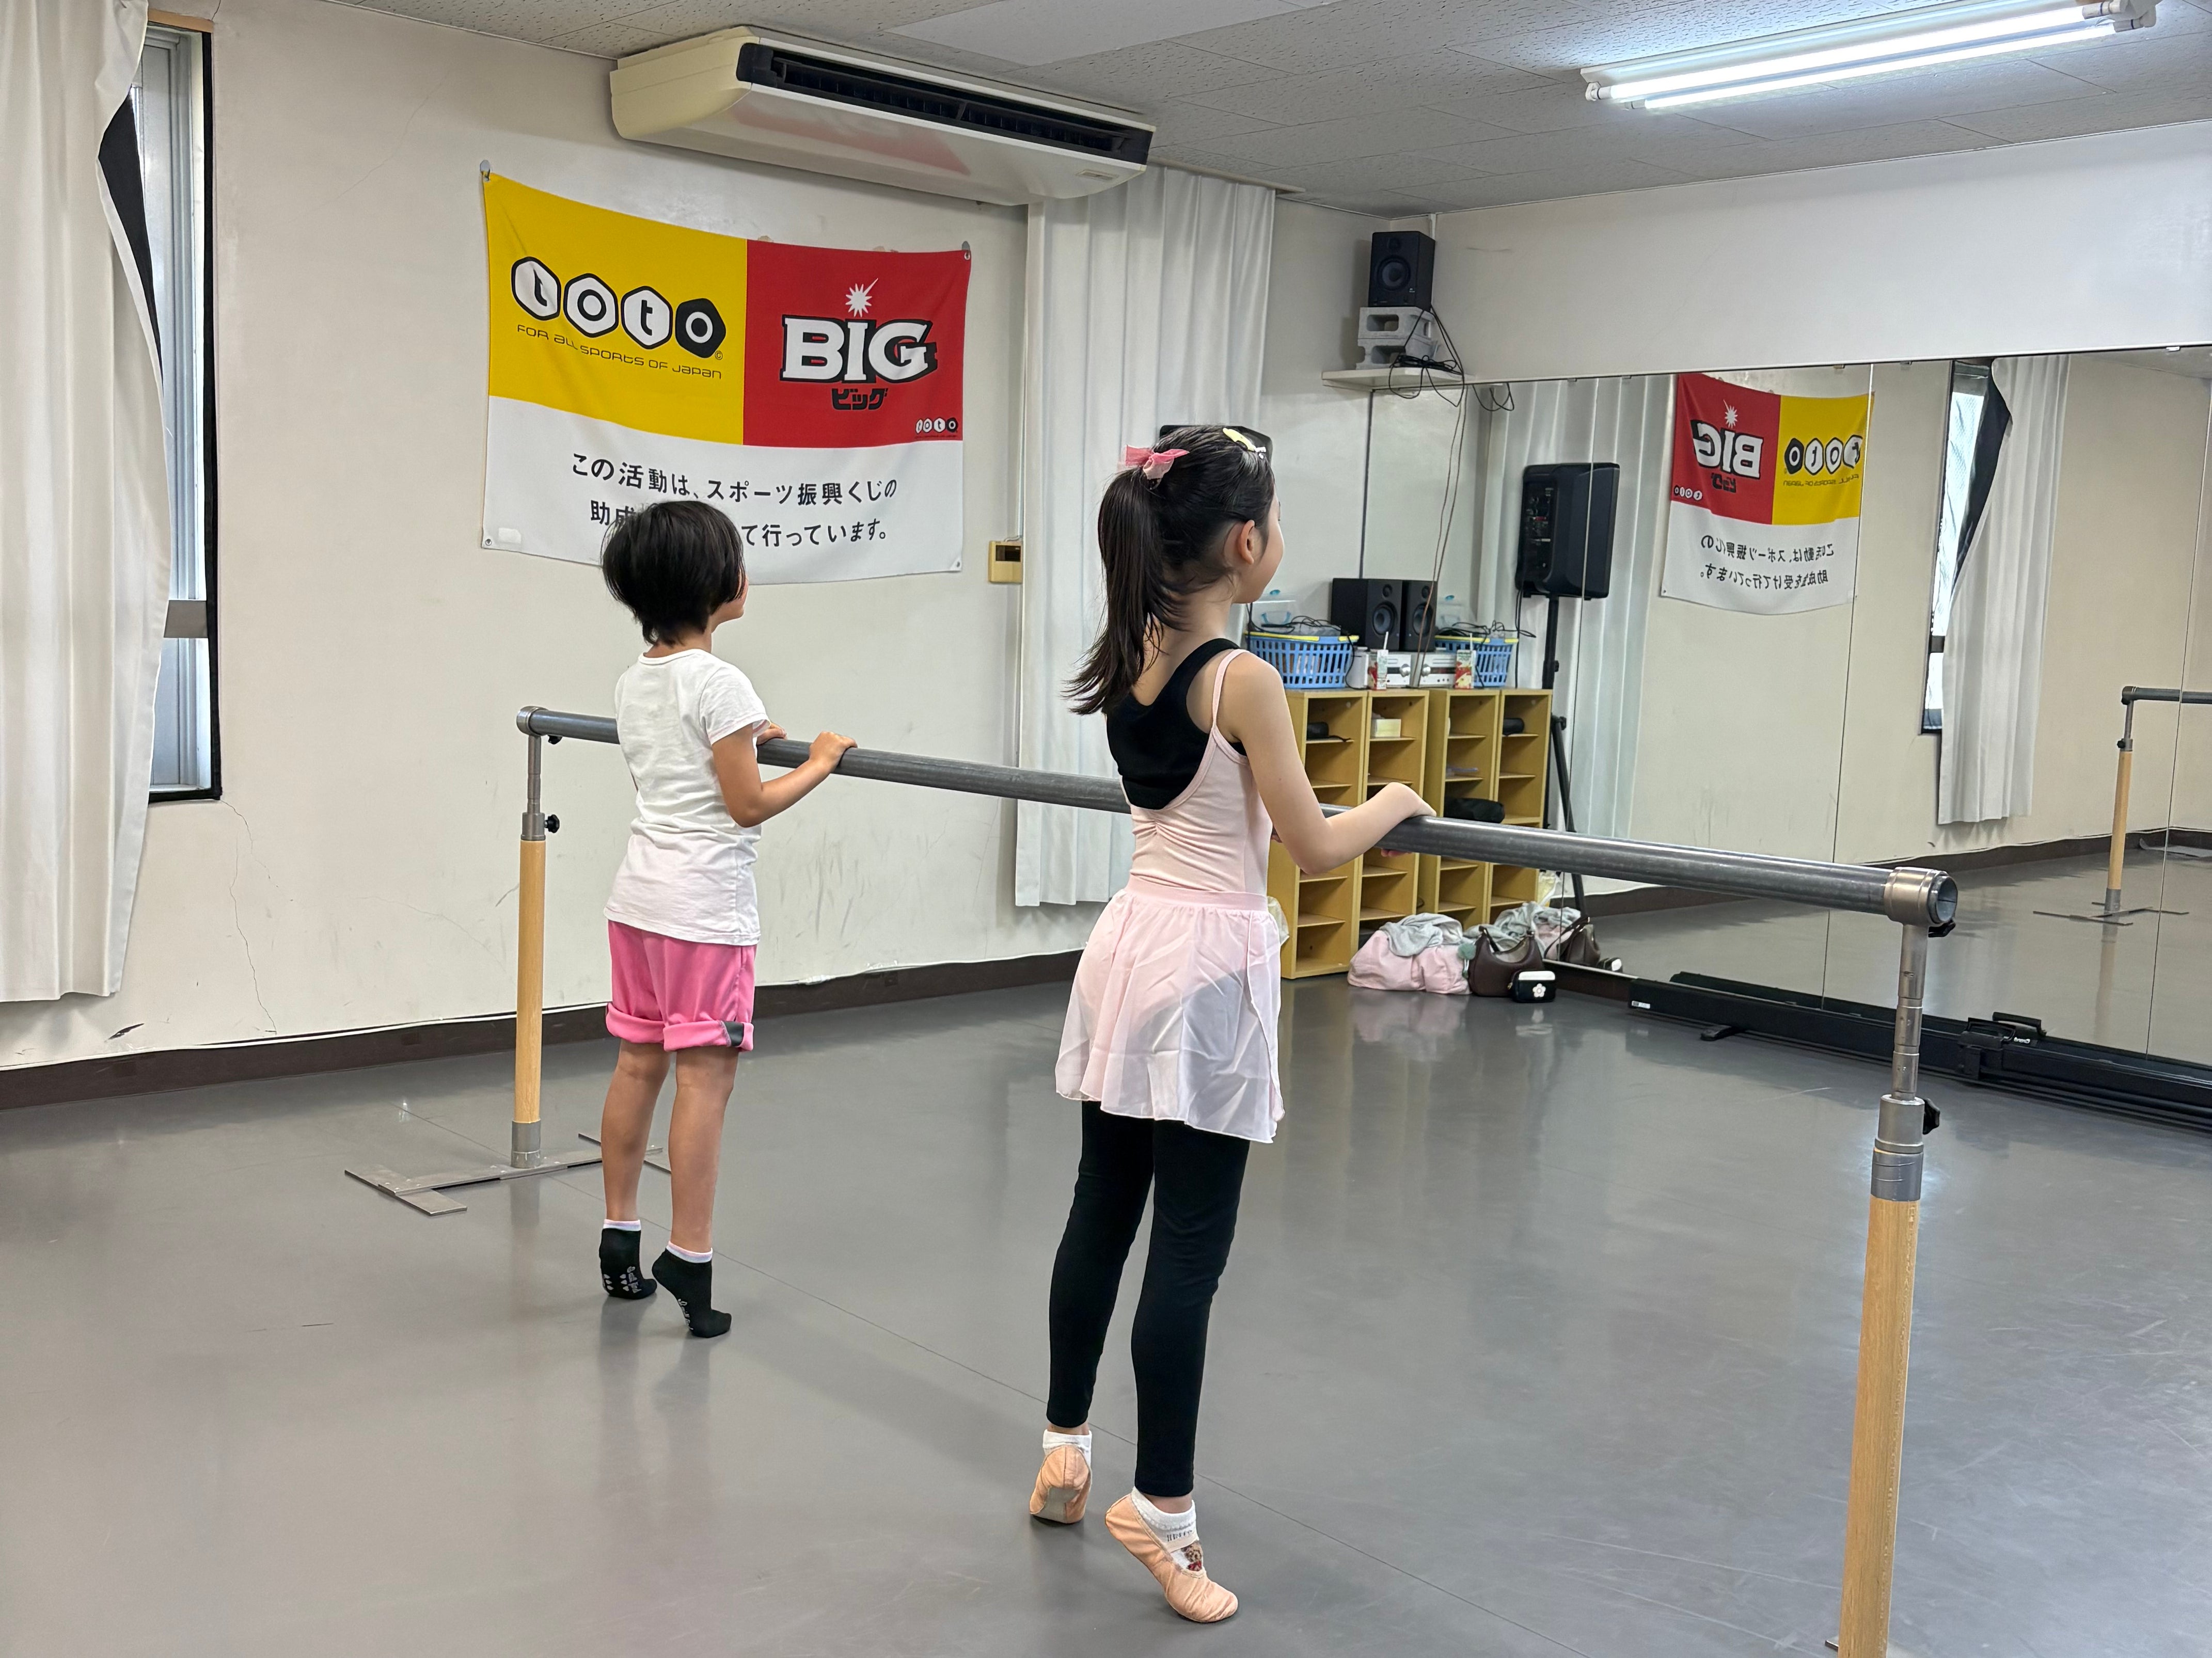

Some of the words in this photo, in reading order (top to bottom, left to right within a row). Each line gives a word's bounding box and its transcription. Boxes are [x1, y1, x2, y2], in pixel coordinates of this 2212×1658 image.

[511, 256, 726, 358] toto
[517, 324, 549, 340] FOR
[648, 359, 669, 370] OF
[780, 314, 938, 383] BIG
[831, 388, 888, 410] ビッグ
[915, 417, 958, 434] toto
[572, 453, 897, 506] この活動は、スポーツ振興くじの
